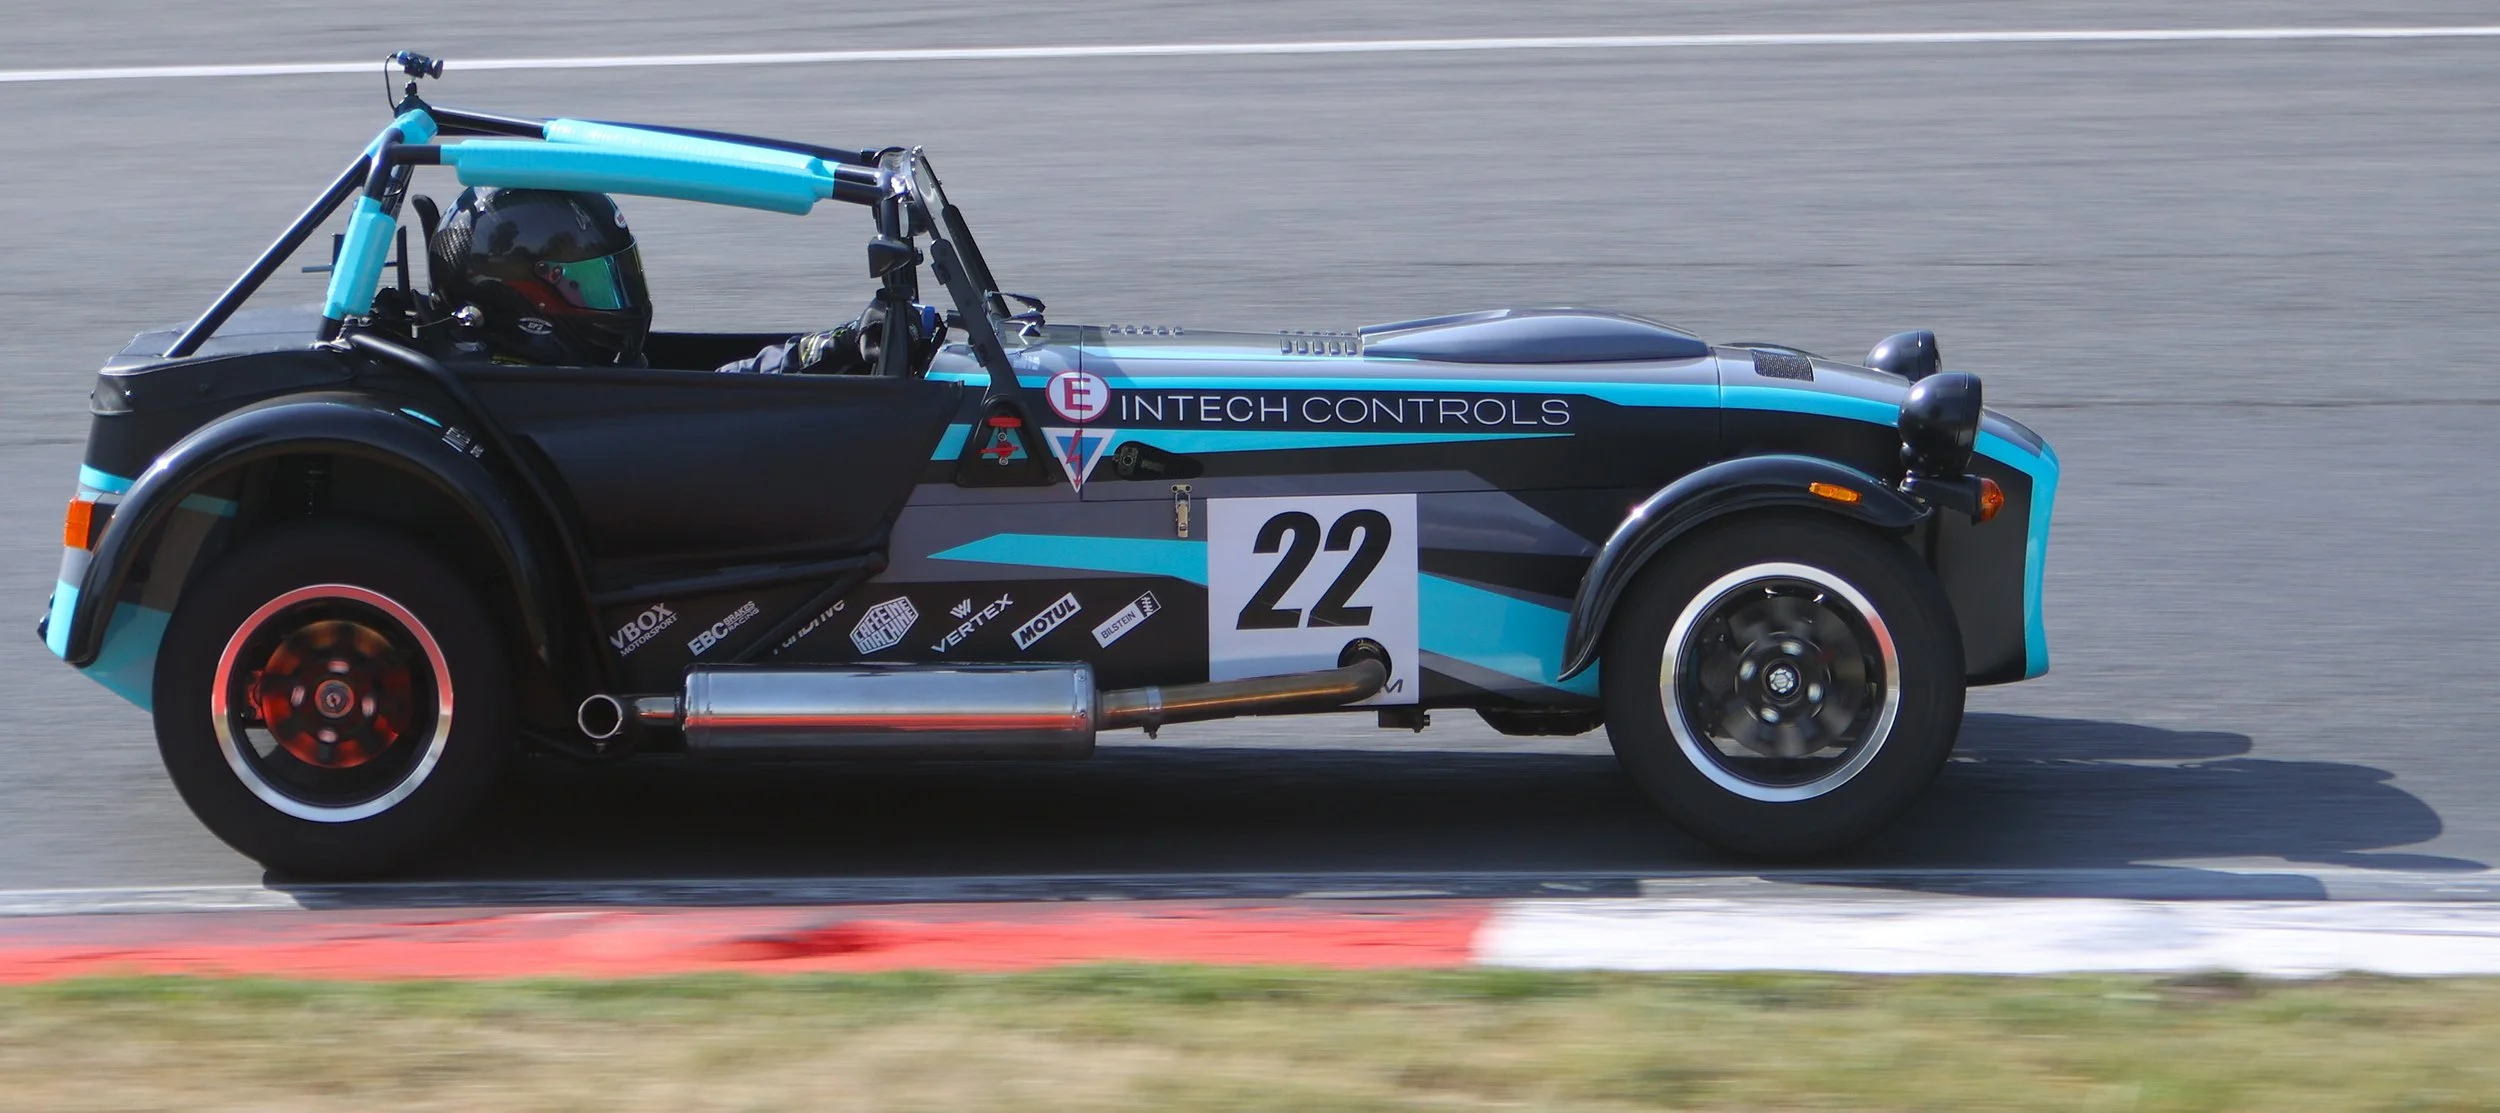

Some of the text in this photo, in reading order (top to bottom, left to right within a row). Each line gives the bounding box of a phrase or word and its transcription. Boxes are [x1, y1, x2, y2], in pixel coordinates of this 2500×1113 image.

[1063, 377, 1093, 411] E
[1121, 395, 1570, 426] INTECH CONTROLS
[1236, 509, 1392, 630] 22
[609, 603, 673, 649] VBOX
[723, 600, 755, 626] BRAKES
[728, 608, 760, 632] RACING
[853, 599, 910, 642] CAFFEINE
[859, 609, 916, 652] MACHINE
[931, 593, 1014, 653] VERTEX
[1019, 598, 1076, 645] MOTUL
[1101, 611, 1136, 639] BILSTEIN
[620, 613, 677, 657] MOTORSPORT
[687, 622, 729, 656] EBC
